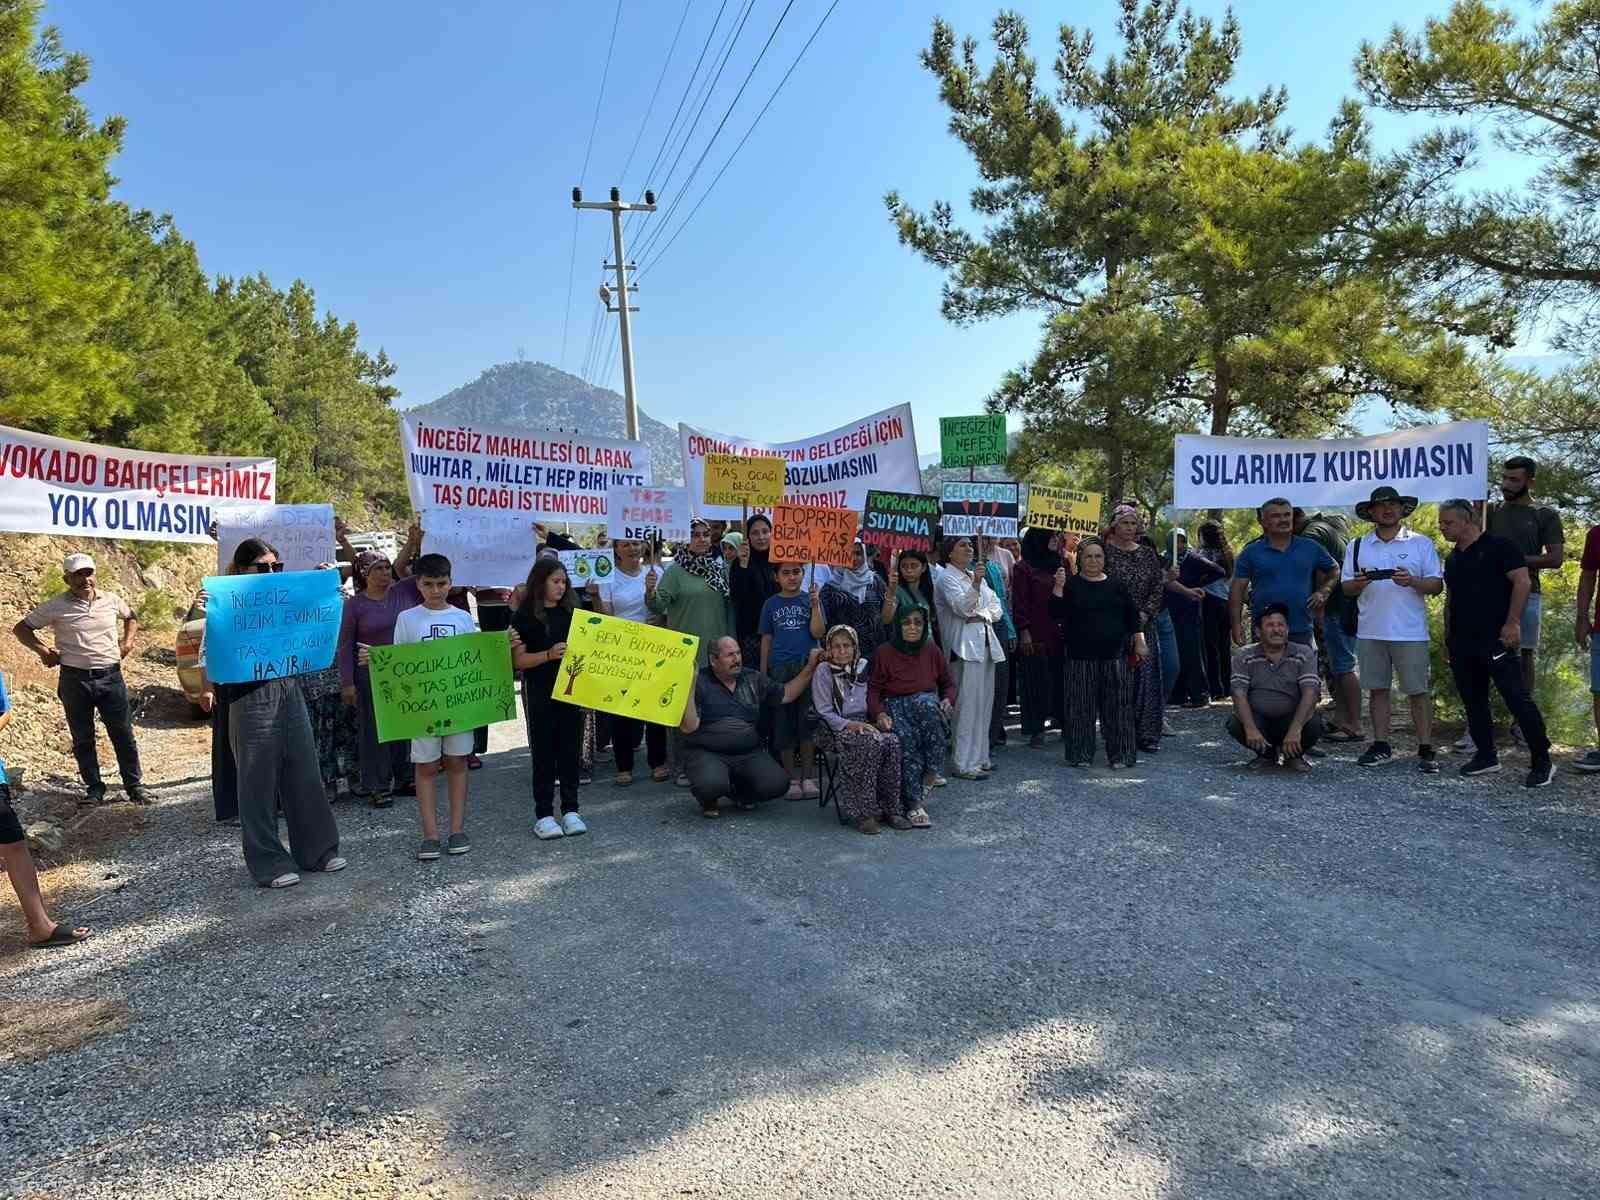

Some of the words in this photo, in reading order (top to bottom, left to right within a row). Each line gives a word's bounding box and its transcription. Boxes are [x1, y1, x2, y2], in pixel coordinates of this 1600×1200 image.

[417, 422, 481, 454] İNCEĞİZ
[486, 434, 573, 463] MAHALLESİ
[576, 446, 633, 469] OLARAK
[809, 424, 871, 460] GELECEĞİ
[875, 415, 904, 446] İÇİN
[0, 443, 97, 486] VOKADO
[104, 457, 272, 501] BAHÇELERİMİZ
[485, 458, 543, 486] MİLLET
[546, 467, 576, 489] HEP
[784, 453, 878, 486] BOZULMASINI
[1191, 453, 1316, 485] SULARIMIZ
[1323, 443, 1474, 483] KURUMASIN
[432, 483, 463, 511] TAŞ
[467, 485, 514, 510] OCAĞI
[517, 486, 608, 516] İSTEMİYORU
[48, 493, 98, 528] YOK
[105, 498, 210, 536] OLMASIN
[778, 505, 851, 529] TOPRAK
[867, 511, 930, 536] SUYUMA
[1029, 510, 1098, 533] İSTEMİYORUZ
[625, 525, 666, 542] DEĞİL
[773, 522, 812, 542] BİZİM
[821, 530, 849, 549] TAŞ
[774, 544, 813, 561] OCAĞI
[817, 549, 854, 563] KİMİN
[596, 630, 622, 646] BEN
[253, 654, 300, 681] HAYIR
